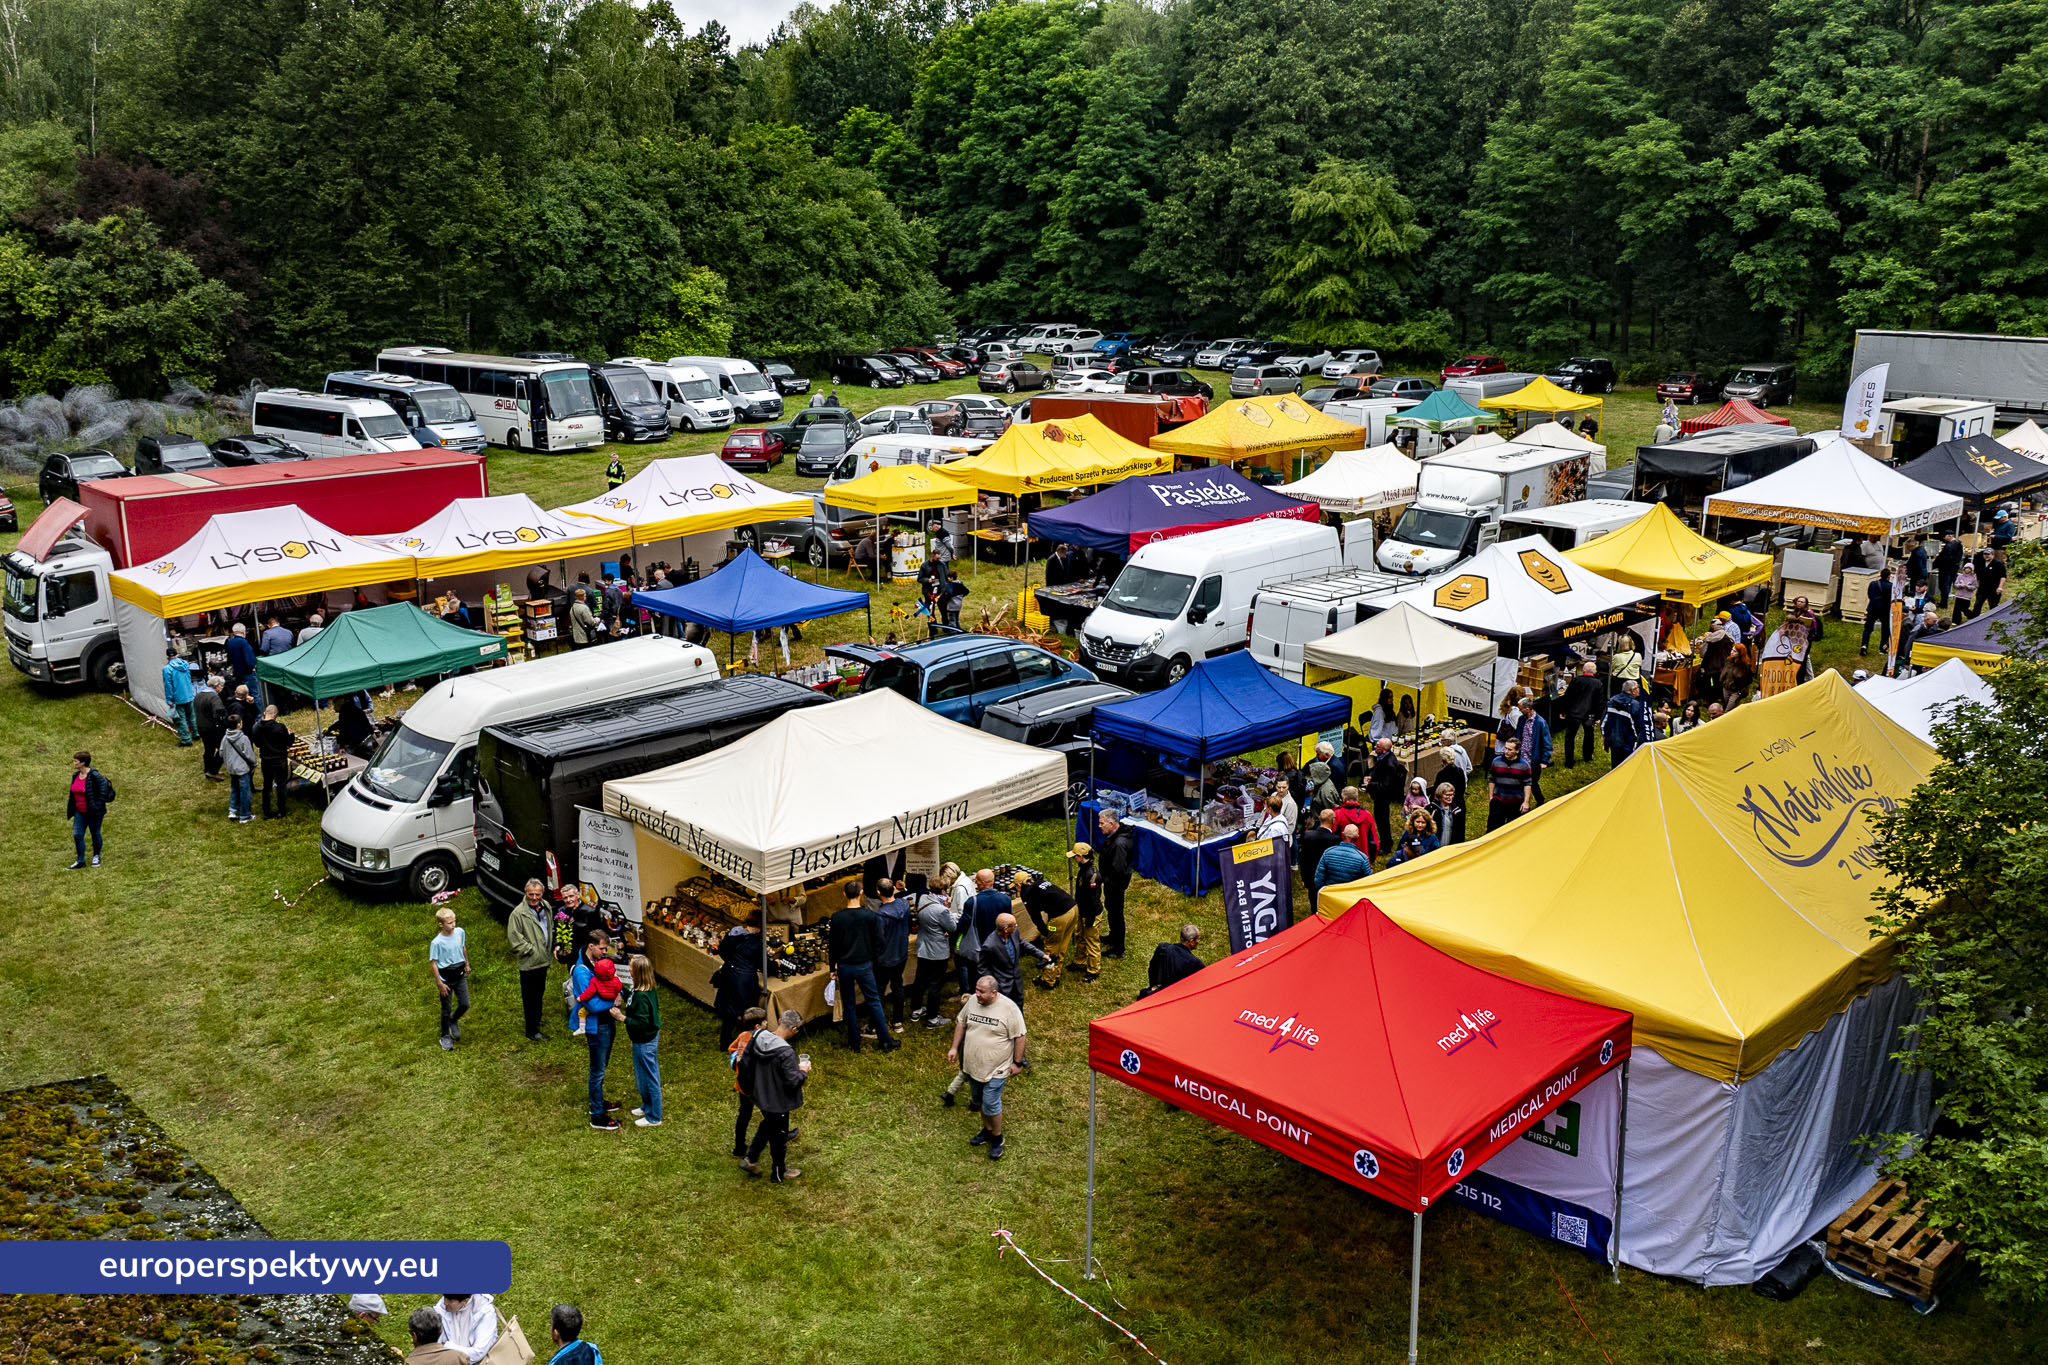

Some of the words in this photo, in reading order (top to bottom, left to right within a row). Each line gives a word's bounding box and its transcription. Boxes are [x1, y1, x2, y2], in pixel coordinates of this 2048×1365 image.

[1864, 382, 1876, 418] ARES
[1040, 471, 1074, 485] Producent
[659, 482, 756, 507] LYSON
[1148, 478, 1246, 507] Pasieka
[1426, 492, 1468, 504] www.bartnik.pl
[1736, 506, 1783, 518] PRODUCENT
[1902, 511, 1930, 530] ARES
[456, 525, 567, 549] LYSON
[210, 538, 342, 570] LYSON
[1562, 612, 1624, 639] www.bzyki.com
[1760, 736, 1798, 762] LYSON
[582, 840, 609, 854] Sprzedaż
[610, 848, 629, 858] miodu
[619, 793, 681, 846] Pasieka
[687, 823, 753, 882] Natura
[787, 826, 882, 880] Pasieka
[890, 799, 970, 846] Natura
[580, 852, 603, 863] Pasieka
[604, 858, 633, 870] NATURA
[602, 882, 610, 890] 501
[1174, 1074, 1252, 1120] MEDICAL
[1256, 1108, 1313, 1145] POINT
[1490, 1094, 1544, 1143] MEDICAL
[1546, 1066, 1579, 1102] POINT
[1528, 1130, 1554, 1145] FIRST
[1555, 1140, 1572, 1152] AID
[1454, 1182, 1478, 1201] 215
[1481, 1192, 1502, 1211] 112
